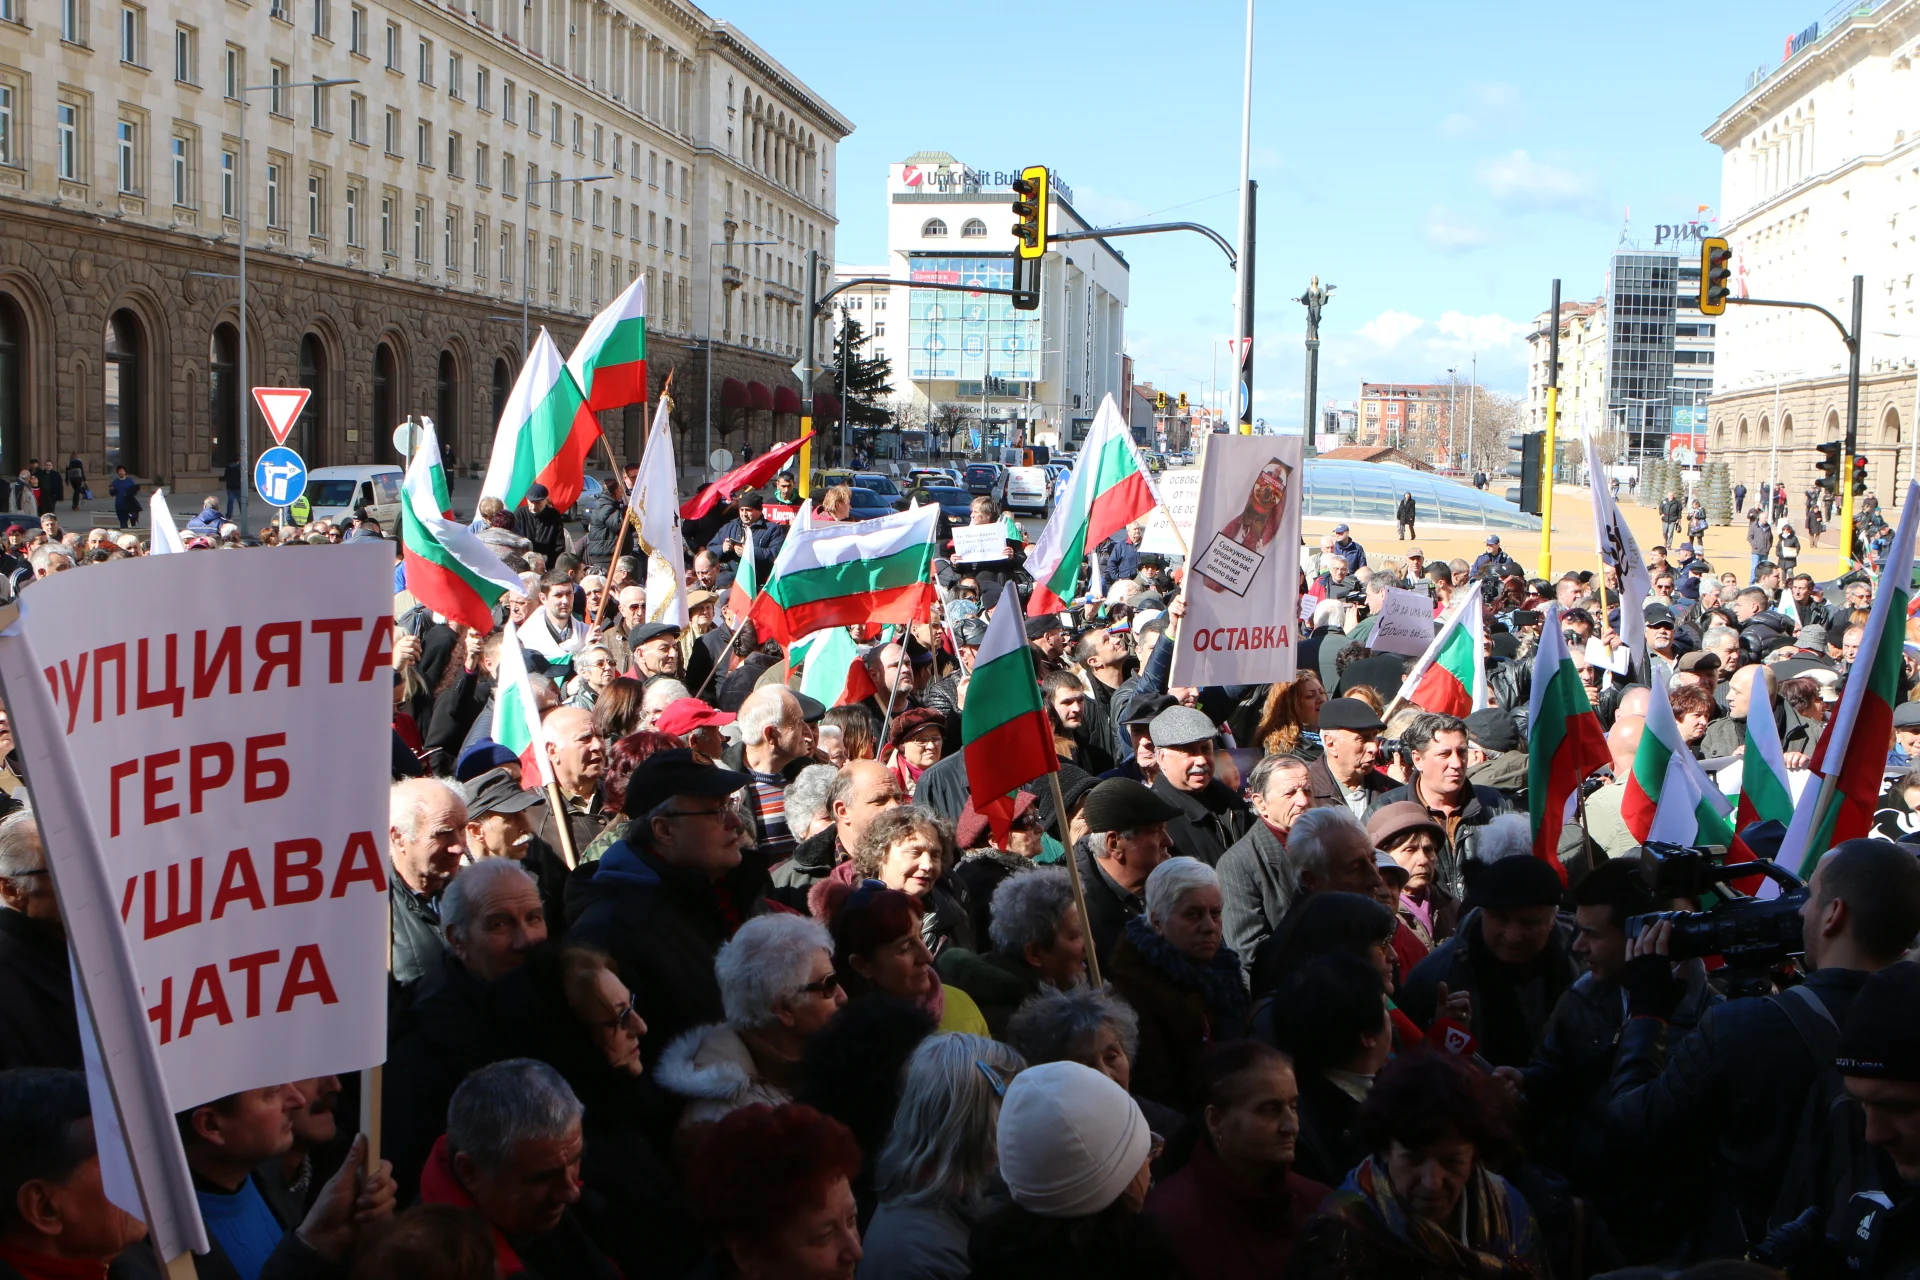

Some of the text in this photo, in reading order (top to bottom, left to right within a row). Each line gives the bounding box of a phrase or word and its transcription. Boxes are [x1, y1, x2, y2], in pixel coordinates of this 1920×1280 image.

[927, 169, 991, 186] UniCredit
[1654, 223, 1709, 245] pwc
[1173, 491, 1184, 499] ОТ
[1172, 505, 1182, 514] СЕ
[1160, 520, 1169, 529] ОТ
[1213, 548, 1251, 572] вреди на вас
[1219, 541, 1254, 563] Суджукгейт
[1207, 564, 1238, 585] около вас.
[1218, 561, 1240, 576] всички
[1193, 625, 1289, 652] ОСТАВКА
[110, 732, 290, 838] ГЕРБ
